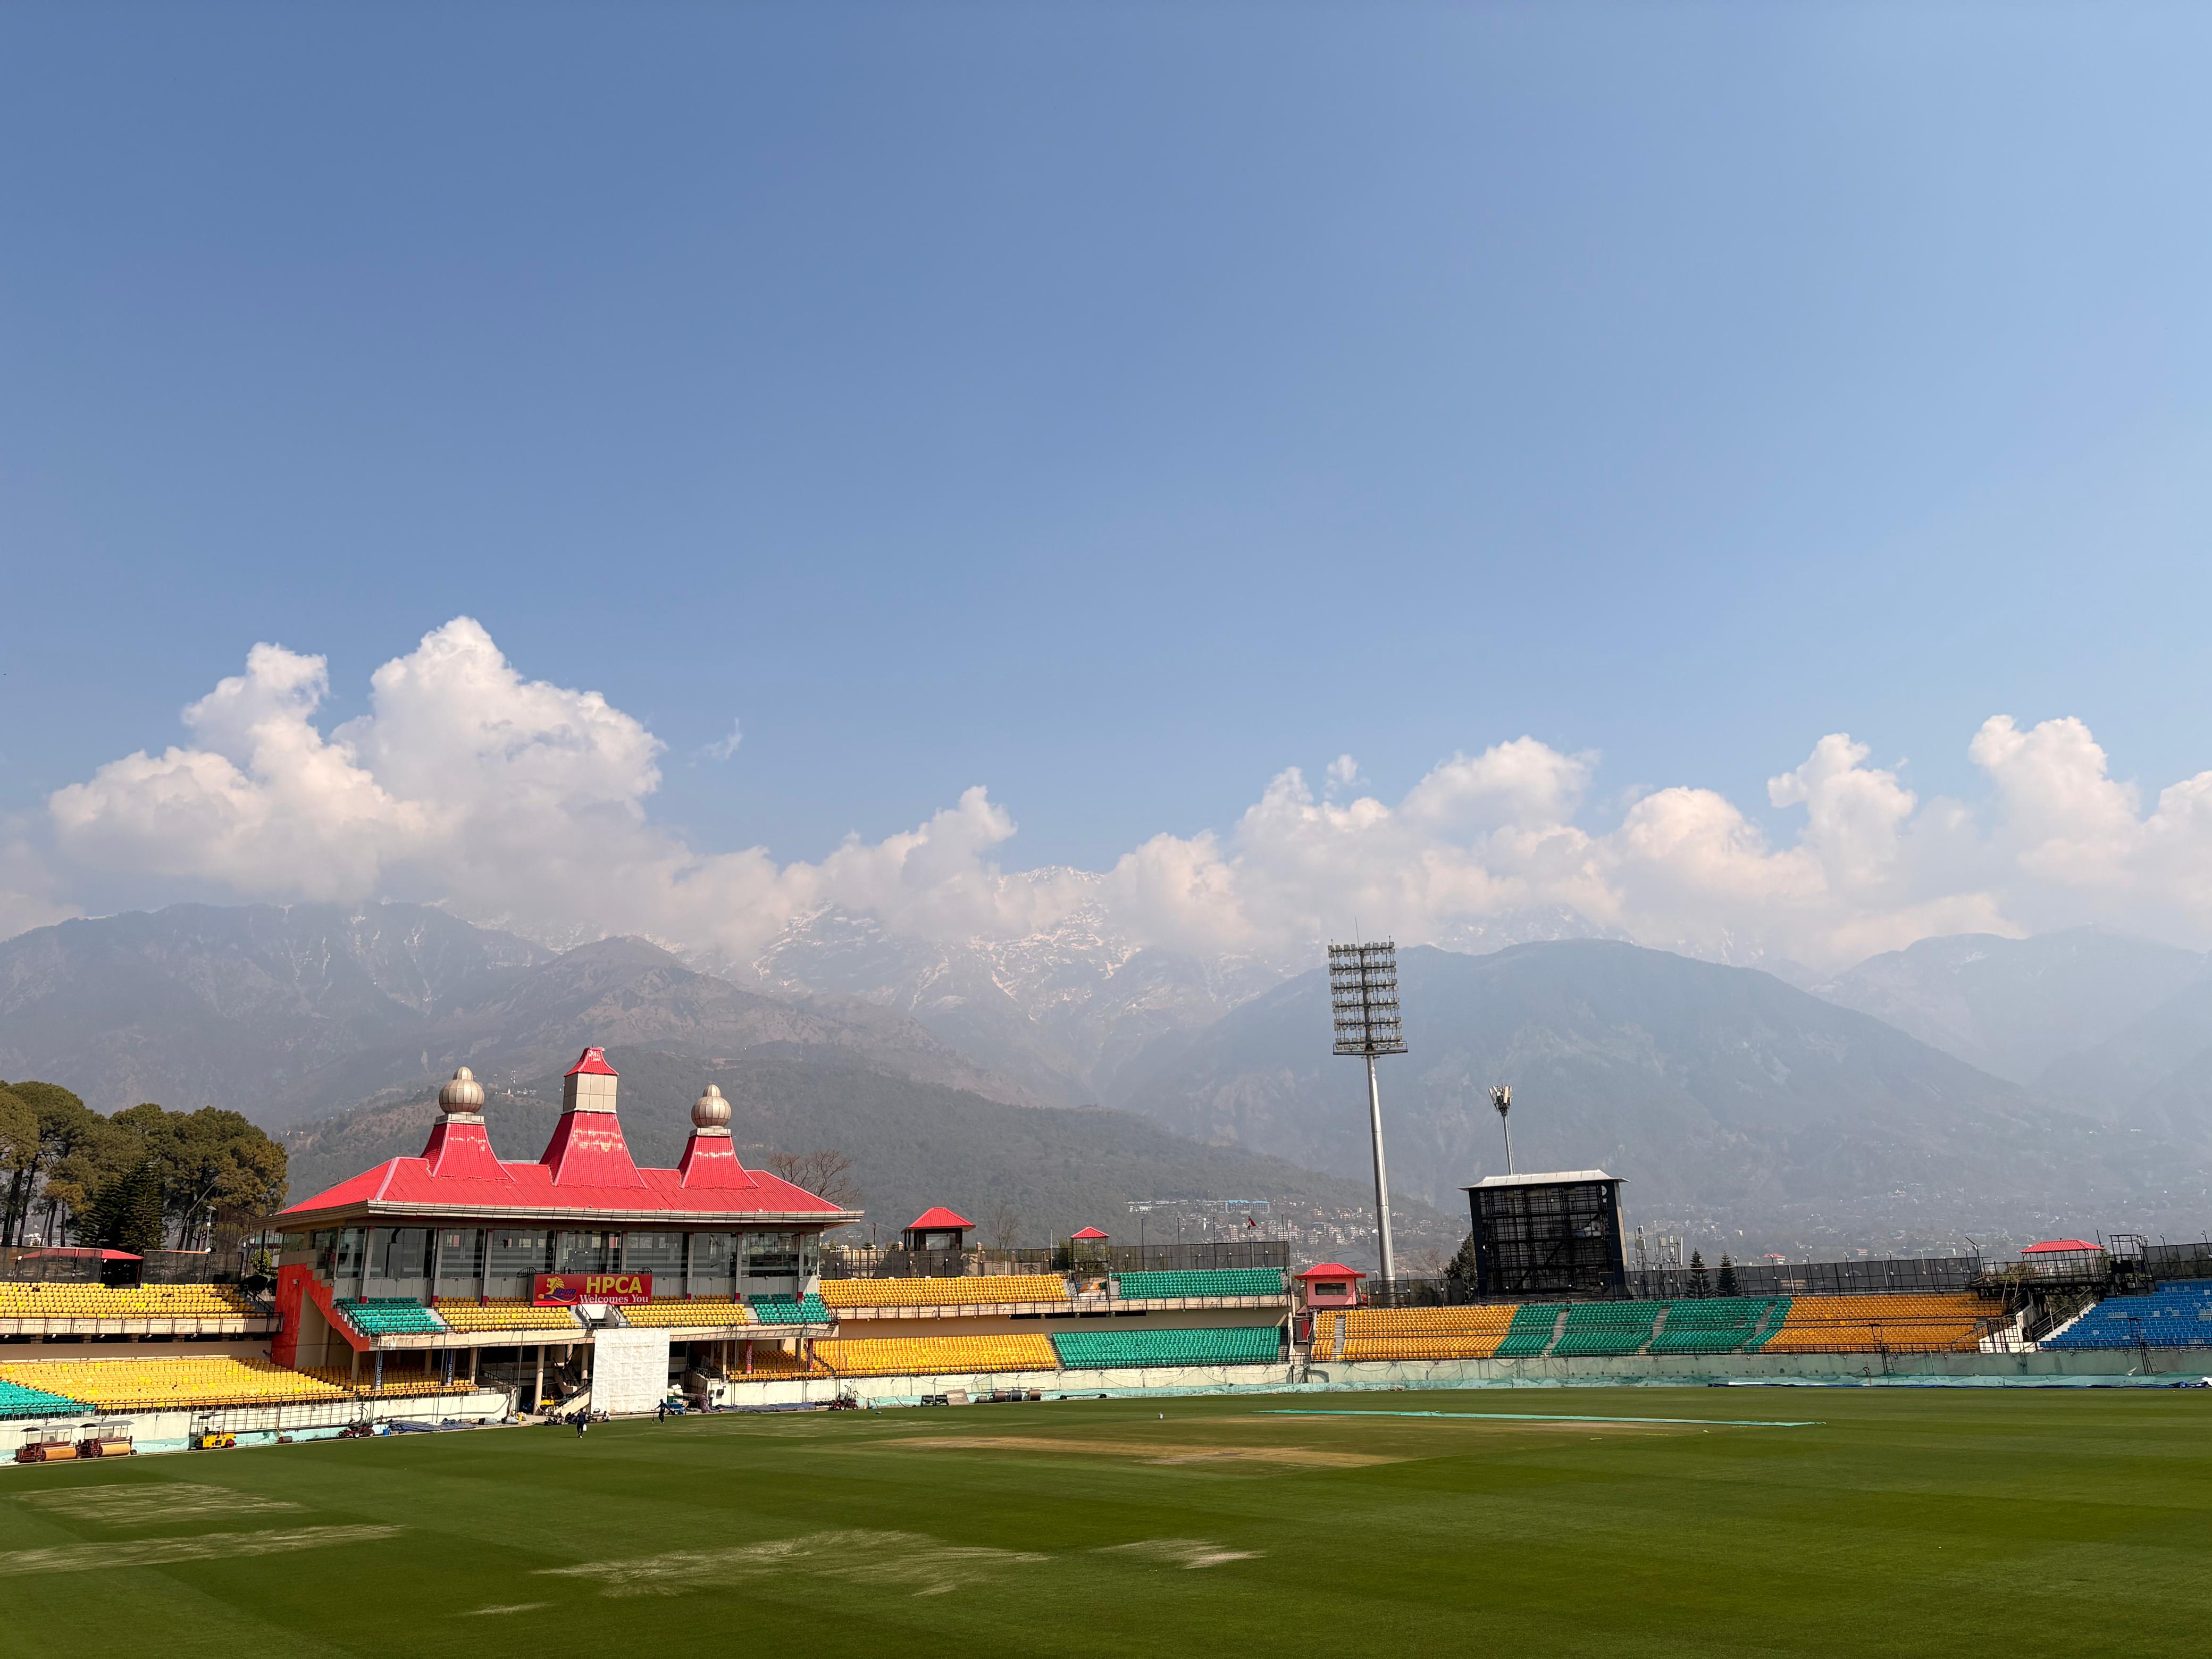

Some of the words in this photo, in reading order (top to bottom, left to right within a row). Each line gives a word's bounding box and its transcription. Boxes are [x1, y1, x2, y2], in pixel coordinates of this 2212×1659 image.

[586, 1276, 642, 1294] HPCA
[580, 1294, 629, 1303] Welcomes
[632, 1294, 648, 1303] You
